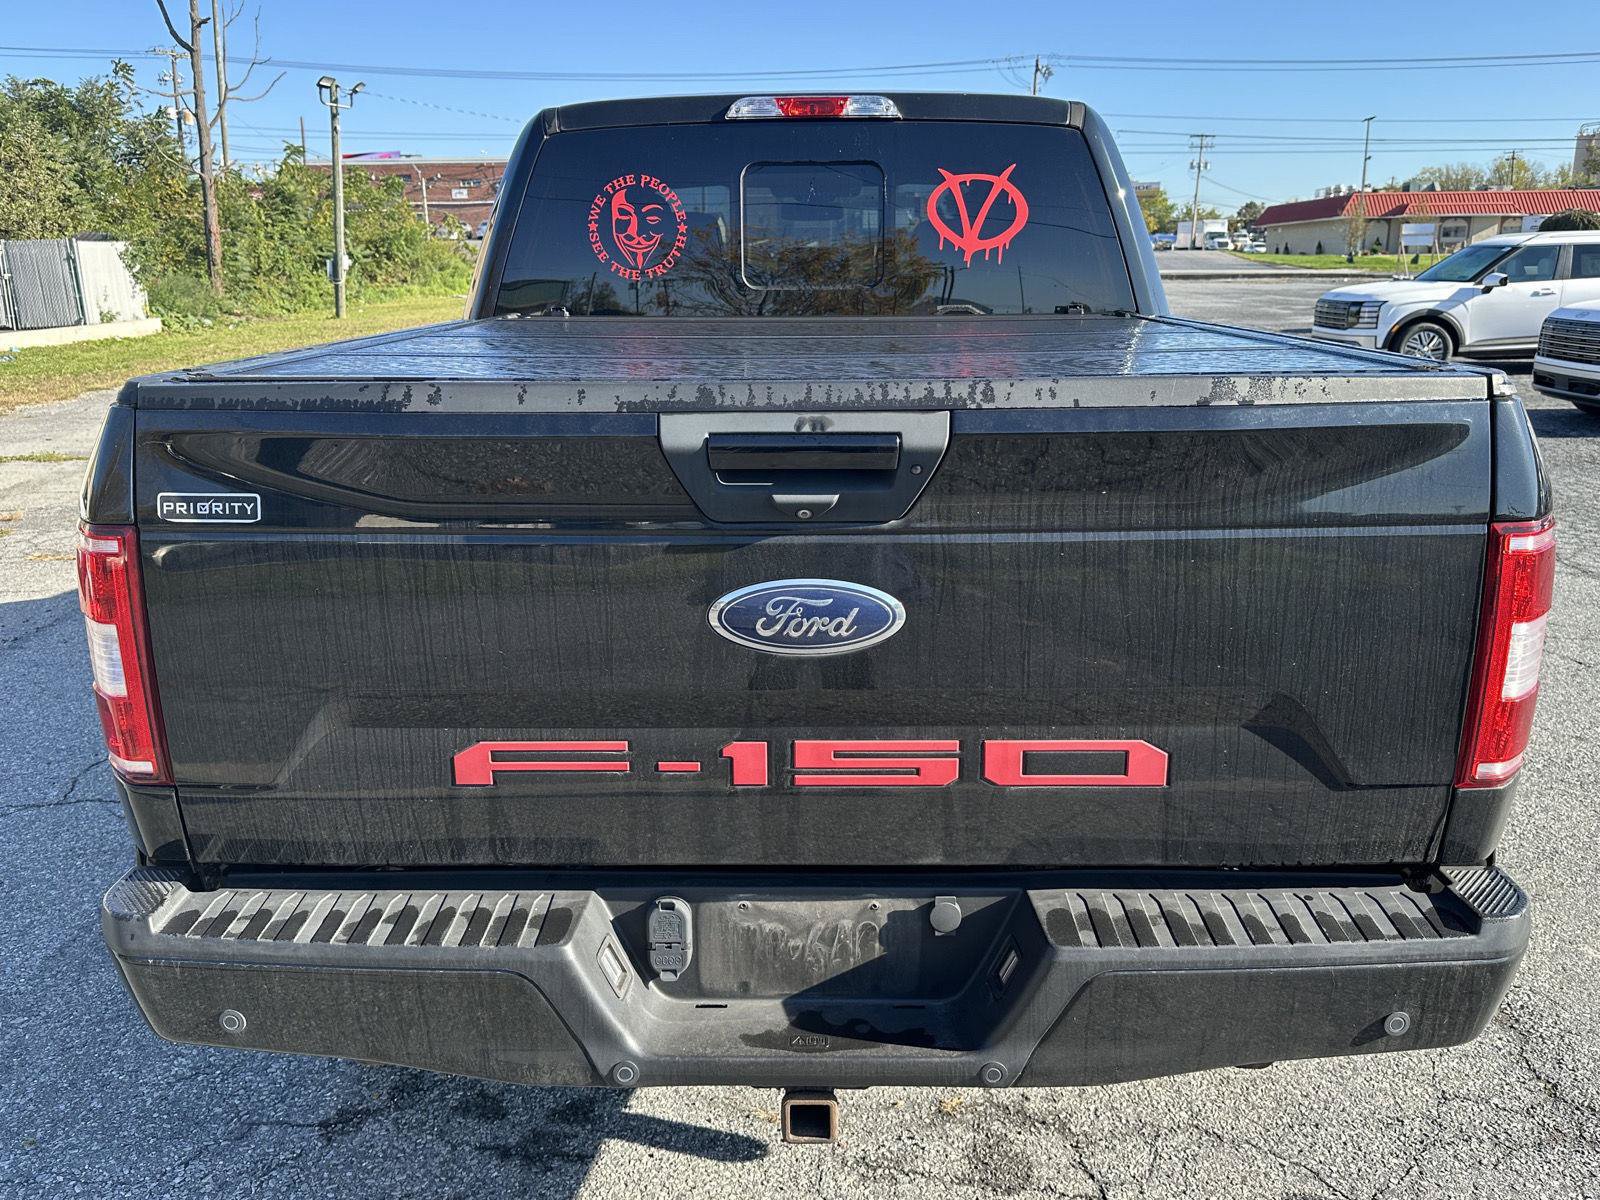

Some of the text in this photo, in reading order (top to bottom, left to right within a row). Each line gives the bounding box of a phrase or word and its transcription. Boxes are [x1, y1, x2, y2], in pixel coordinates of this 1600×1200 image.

[588, 174, 687, 222] WE THE PEOPLE
[589, 232, 687, 281] SEE THE TRUTH
[163, 500, 255, 515] PRIORITY
[755, 596, 859, 638] Ford
[453, 739, 1170, 787] F-150
